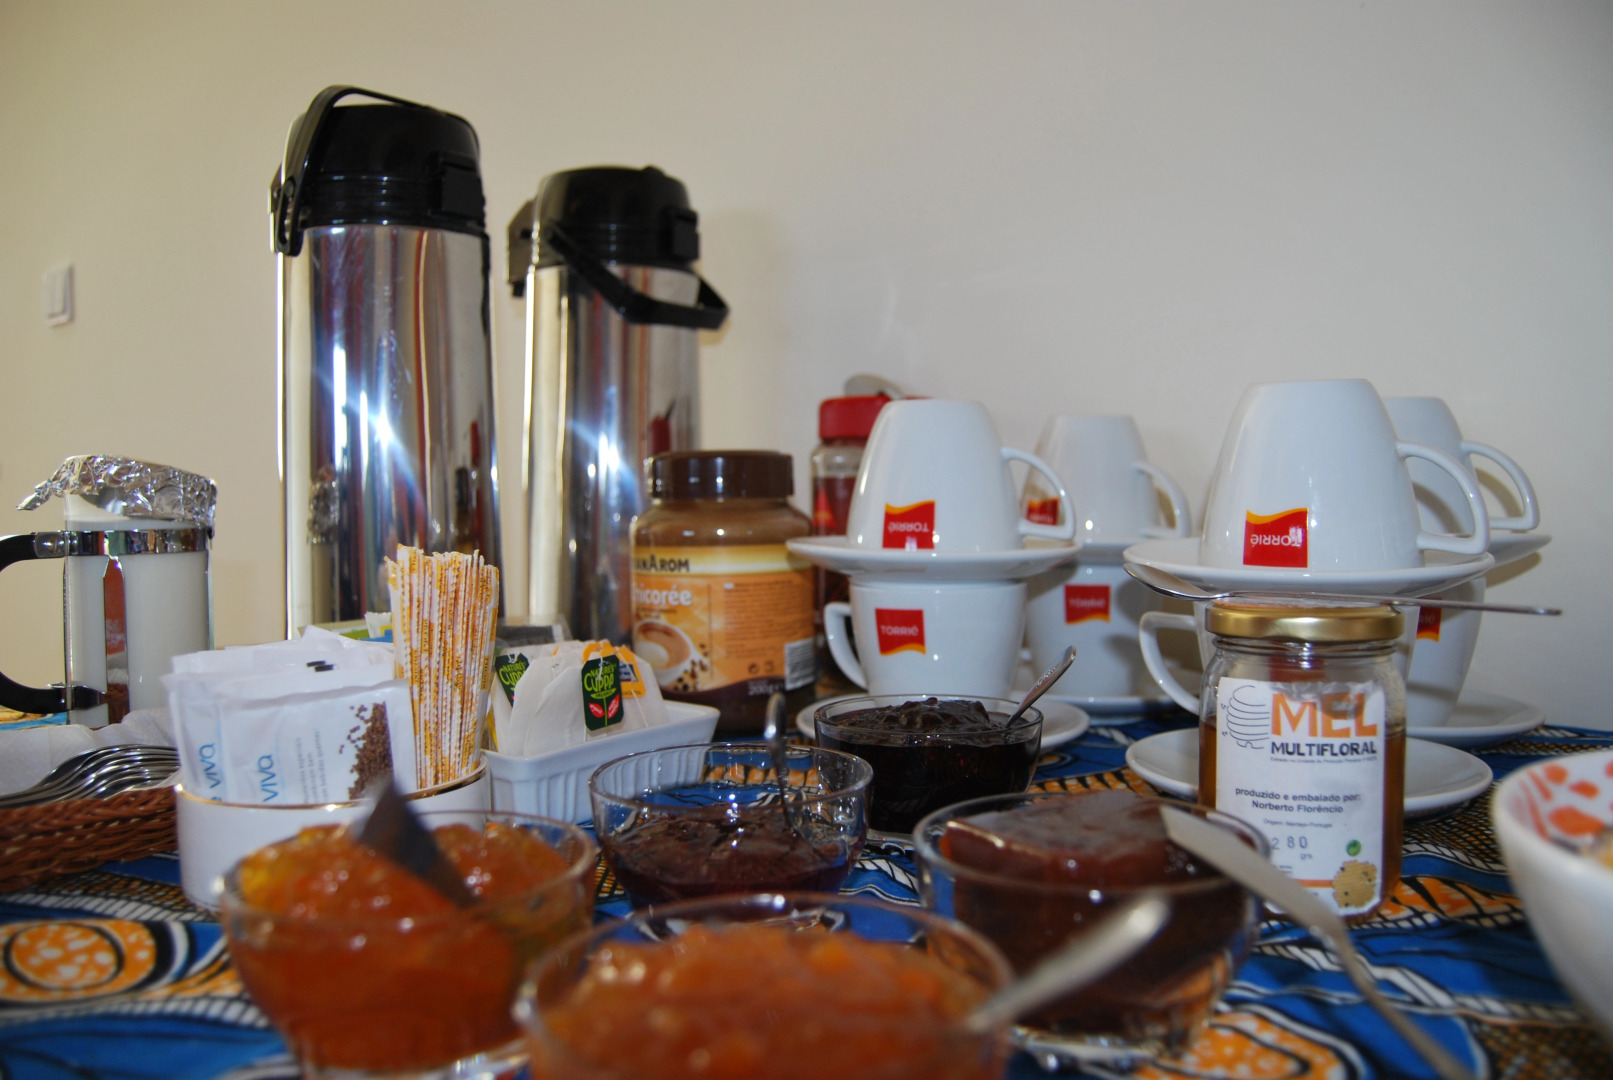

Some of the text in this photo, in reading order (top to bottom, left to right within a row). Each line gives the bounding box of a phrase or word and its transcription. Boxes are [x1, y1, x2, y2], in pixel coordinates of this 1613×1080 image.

[499, 668, 526, 686] CUPP
[584, 672, 615, 693] CUPPA
[1271, 691, 1378, 738] MEL
[1270, 740, 1377, 757] MULTIFLORAL
[1235, 788, 1281, 800] produzido
[1291, 793, 1341, 802] embalado
[1252, 800, 1344, 814] Norberto Florêncio
